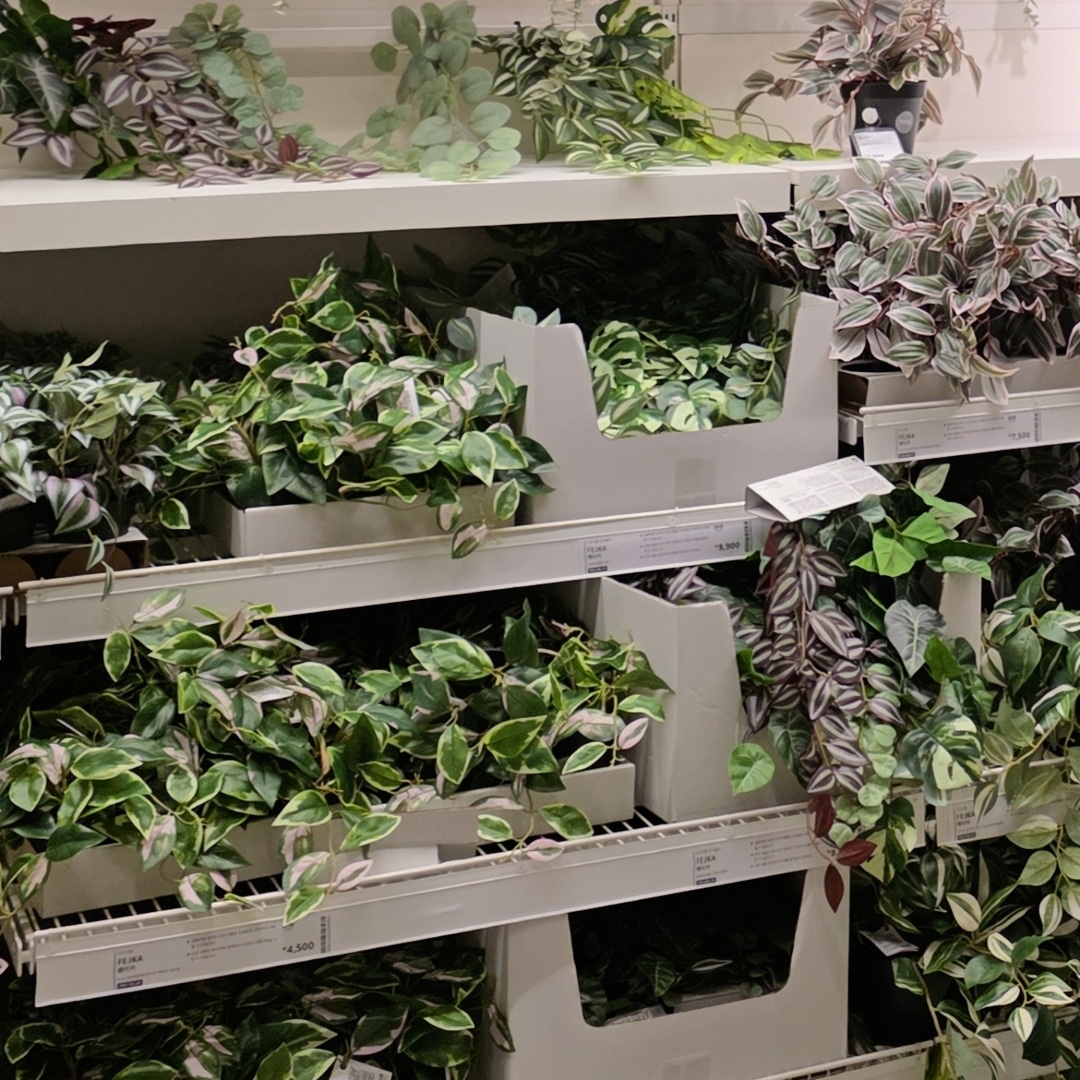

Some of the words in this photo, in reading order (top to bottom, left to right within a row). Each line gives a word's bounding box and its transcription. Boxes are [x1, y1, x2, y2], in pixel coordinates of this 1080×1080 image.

[587, 545, 607, 555] FEJKA
[696, 855, 717, 865] FEJKA
[117, 955, 144, 966] FEJKA
